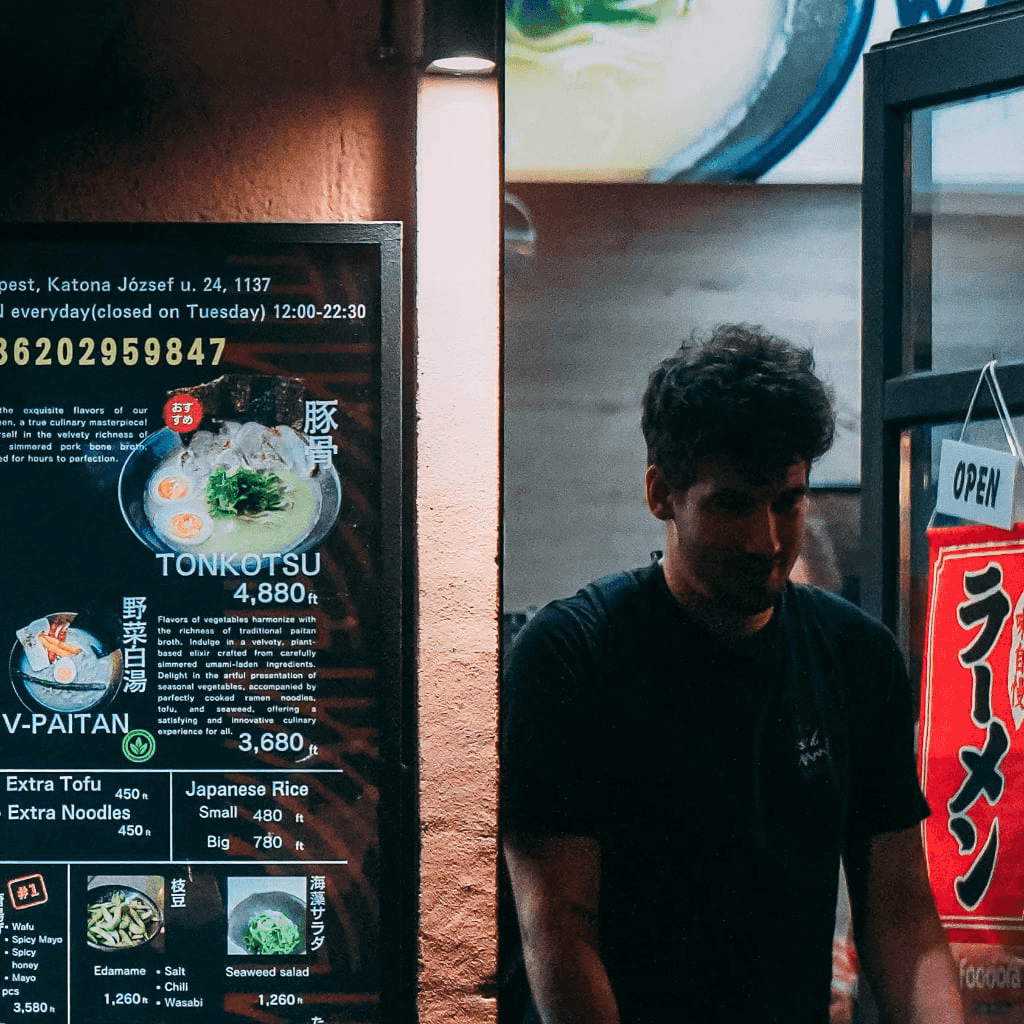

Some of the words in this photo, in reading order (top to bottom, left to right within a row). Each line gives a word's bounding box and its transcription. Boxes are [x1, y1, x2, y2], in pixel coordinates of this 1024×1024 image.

[48, 277, 110, 291] Katona
[118, 277, 174, 291] József
[181, 281, 195, 291] u.
[204, 277, 226, 293] 24,
[235, 277, 270, 291] 1137
[12, 304, 151, 321] everyday(closed
[159, 308, 179, 318] on
[187, 304, 265, 322] Tuesday)
[274, 304, 365, 318] 12:00-22:30
[24, 407, 64, 415] exquisite
[50, 419, 86, 427] culinary
[304, 399, 338, 468] 豚骨
[953, 460, 1000, 509] OPEN
[156, 553, 321, 577] TONKOTSU
[123, 597, 147, 692] 野菜白湯
[2, 713, 129, 735] V-PAITAN
[948, 561, 1012, 912] ラーメン
[7, 776, 54, 791] Extra
[60, 776, 101, 791] Tofu
[186, 781, 265, 799] Japanese
[272, 781, 308, 796] Rice
[8, 805, 55, 820] Extra
[62, 804, 130, 820] Noodles
[199, 806, 237, 818] Small
[253, 809, 282, 821] 480
[208, 835, 229, 850] Big
[254, 836, 282, 849] 780
[17, 884, 39, 900] #1
[171, 878, 186, 907] 枝豆
[310, 876, 325, 950] 海藻サラダ
[12, 936, 36, 945] Spicy
[39, 936, 62, 944] Mayo
[12, 948, 36, 957] Spicy
[12, 961, 38, 970] honey
[94, 966, 146, 975] Edamame
[165, 966, 185, 976] Salt
[226, 967, 276, 977] Seaweed
[280, 967, 309, 976] salad
[12, 974, 36, 983] Mayo
[2, 989, 19, 997] pcs
[165, 982, 188, 991] Chili
[105, 993, 140, 1005] 1,260
[165, 998, 203, 1007] Wasabi
[259, 994, 295, 1006] 1,260
[14, 1002, 47, 1013] 3,580
